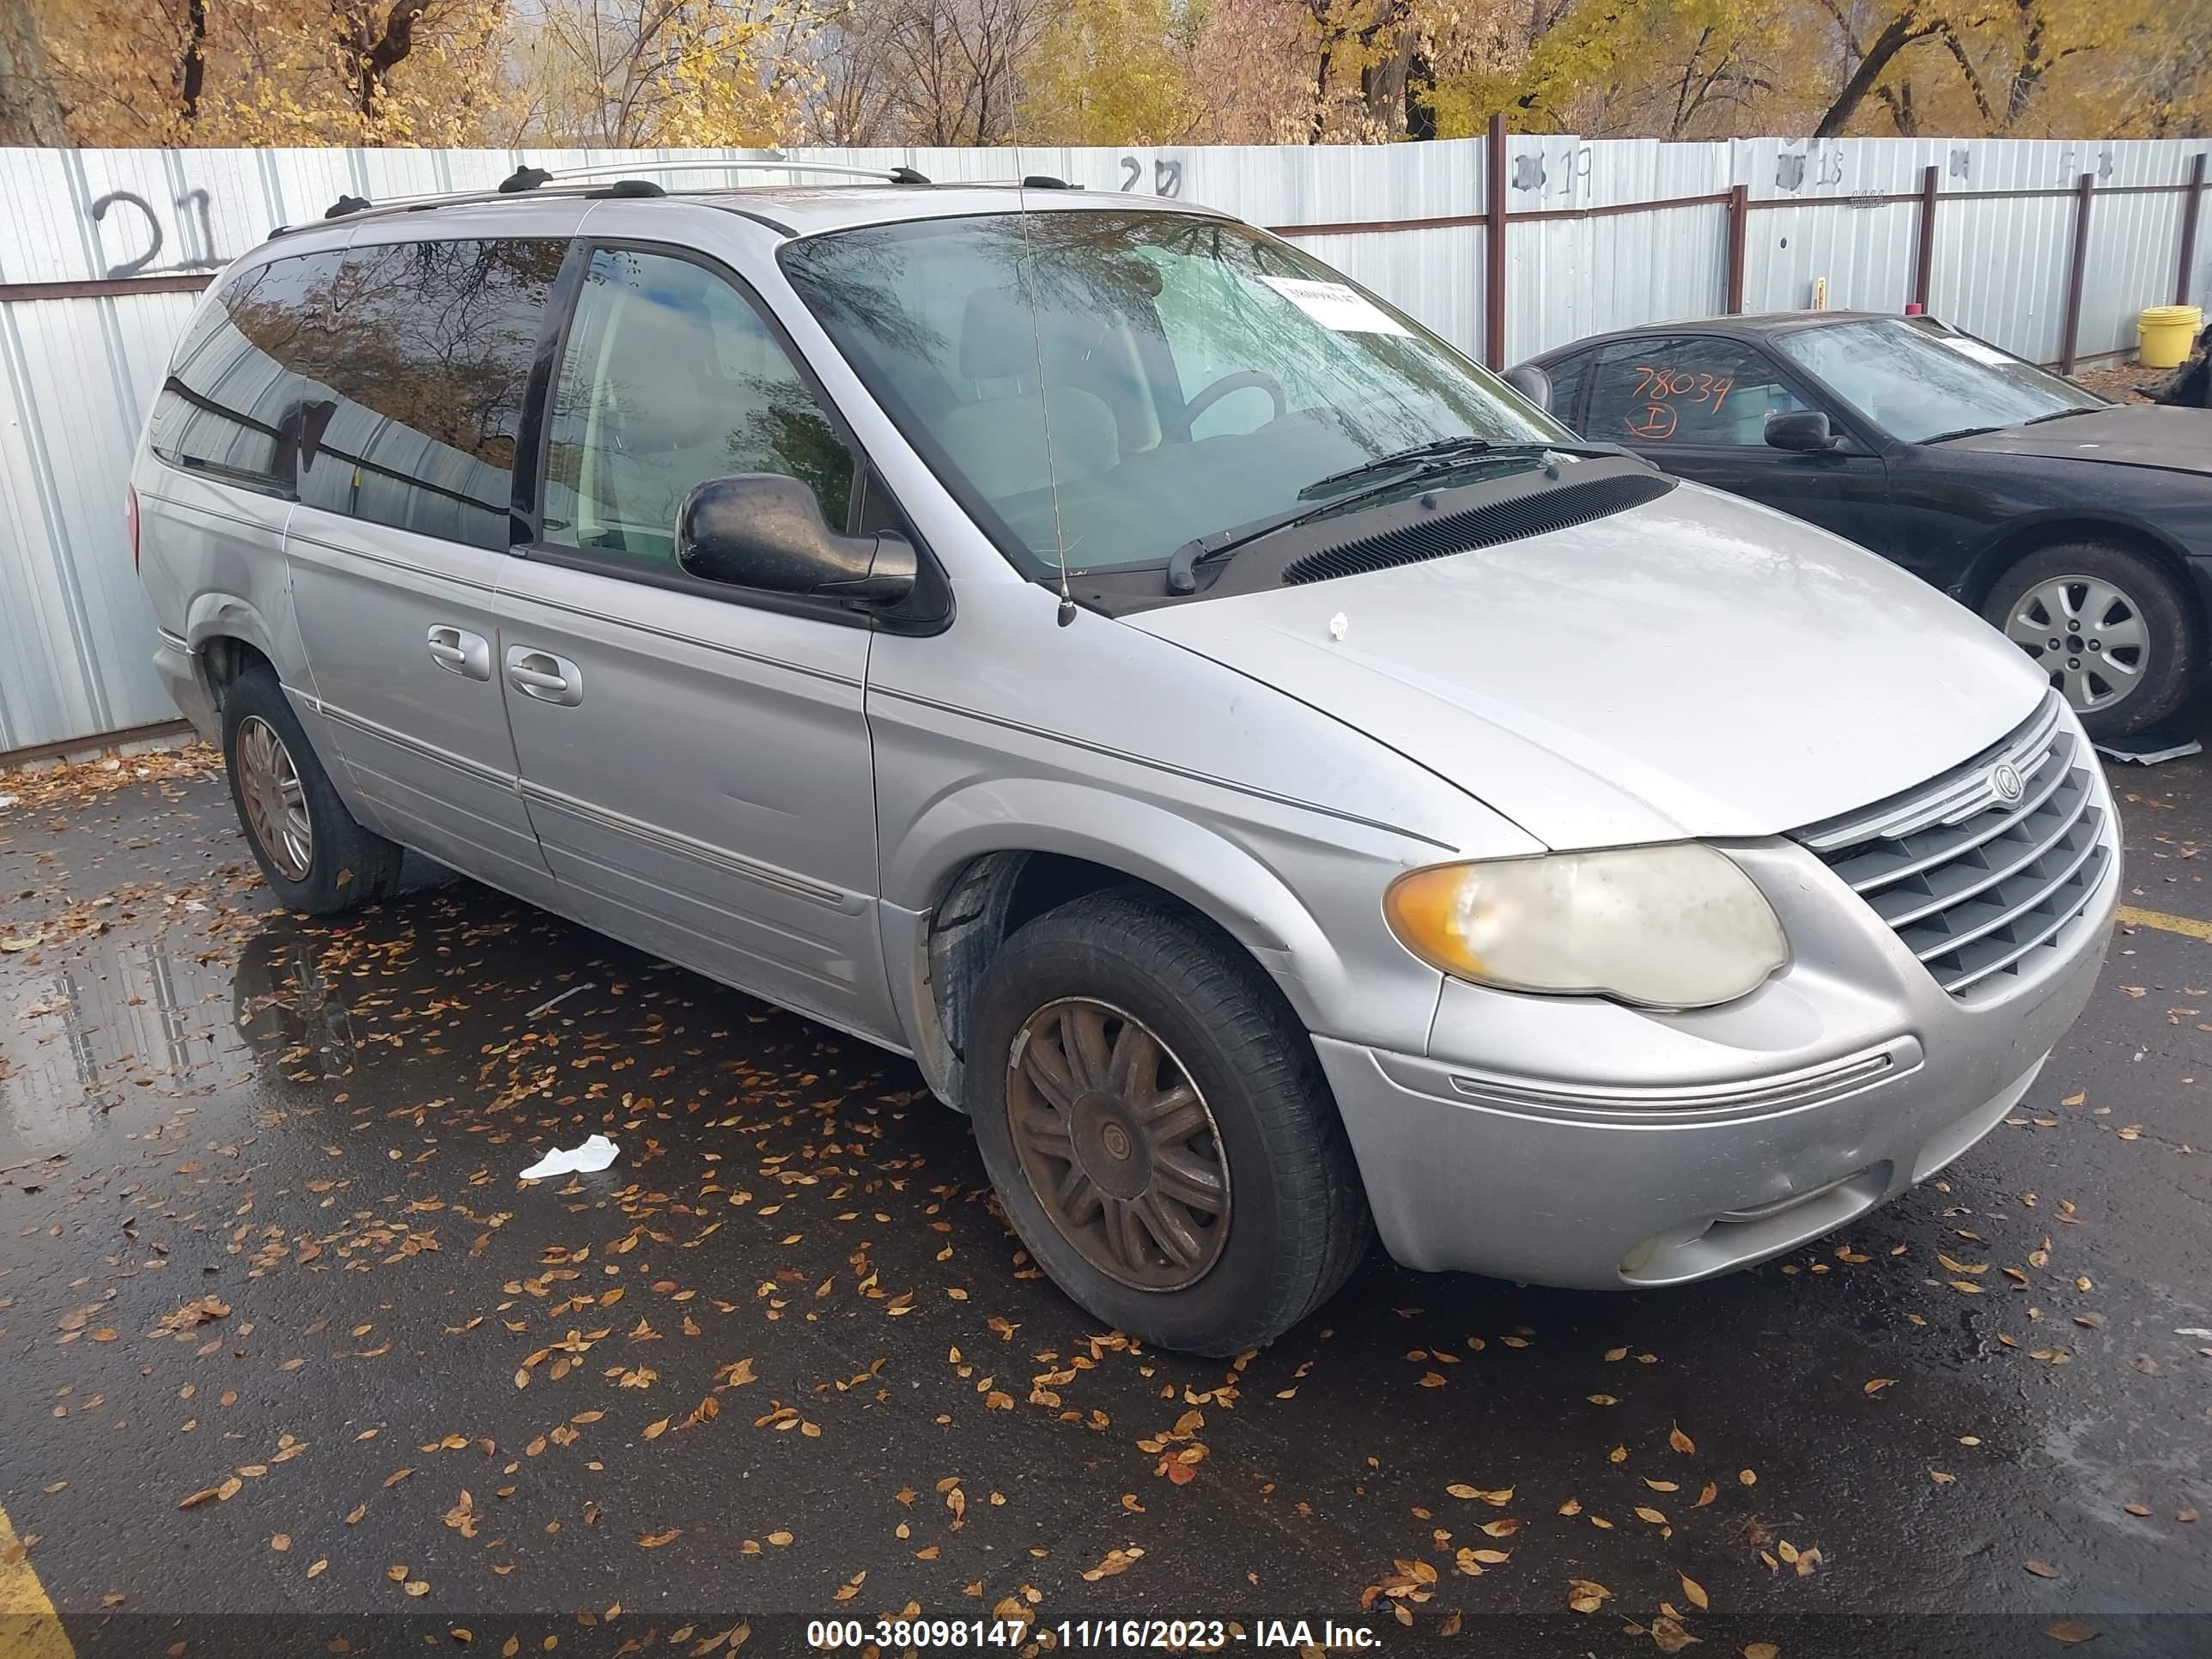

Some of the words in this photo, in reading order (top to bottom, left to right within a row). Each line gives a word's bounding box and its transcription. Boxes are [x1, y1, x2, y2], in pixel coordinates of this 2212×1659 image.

[1559, 147, 1591, 198] 19
[1816, 150, 1844, 186] 18
[92, 188, 235, 280] 21
[1631, 367, 1735, 416] 78034
